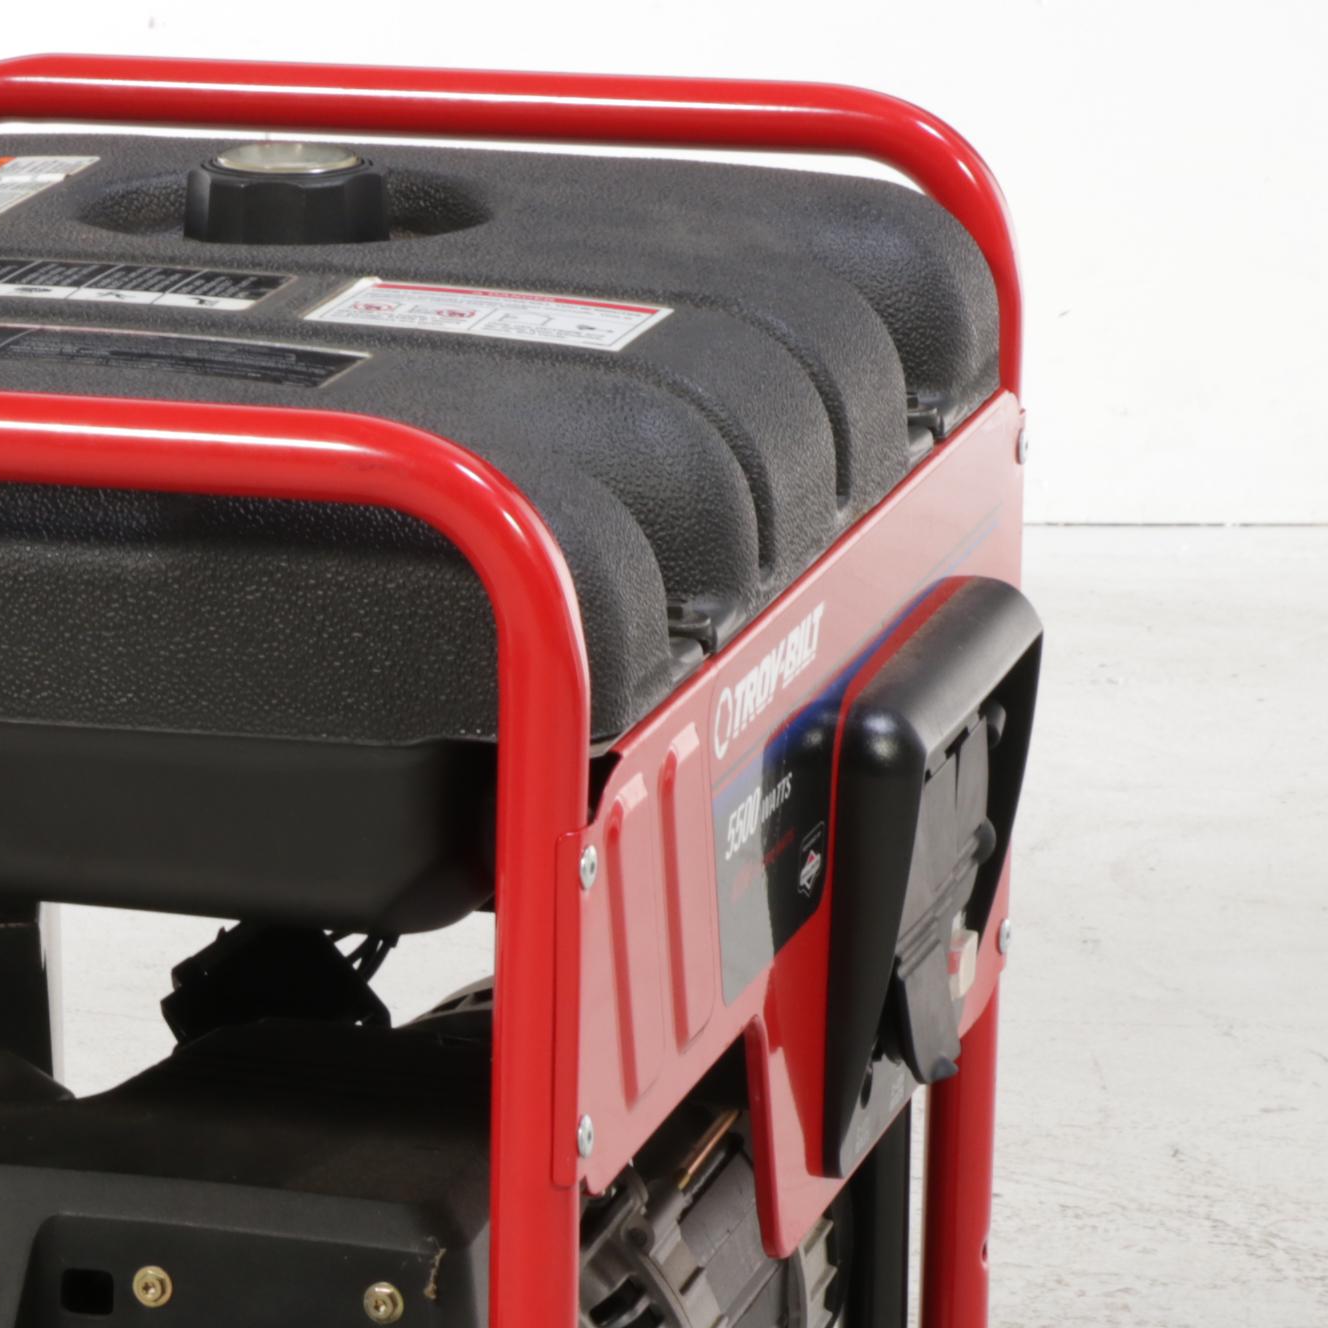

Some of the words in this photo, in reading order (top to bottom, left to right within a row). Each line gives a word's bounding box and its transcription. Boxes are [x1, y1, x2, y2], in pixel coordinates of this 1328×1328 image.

[732, 601, 824, 740] TROY-BILT
[725, 785, 762, 861] 5500
[760, 772, 793, 824] WATTS
